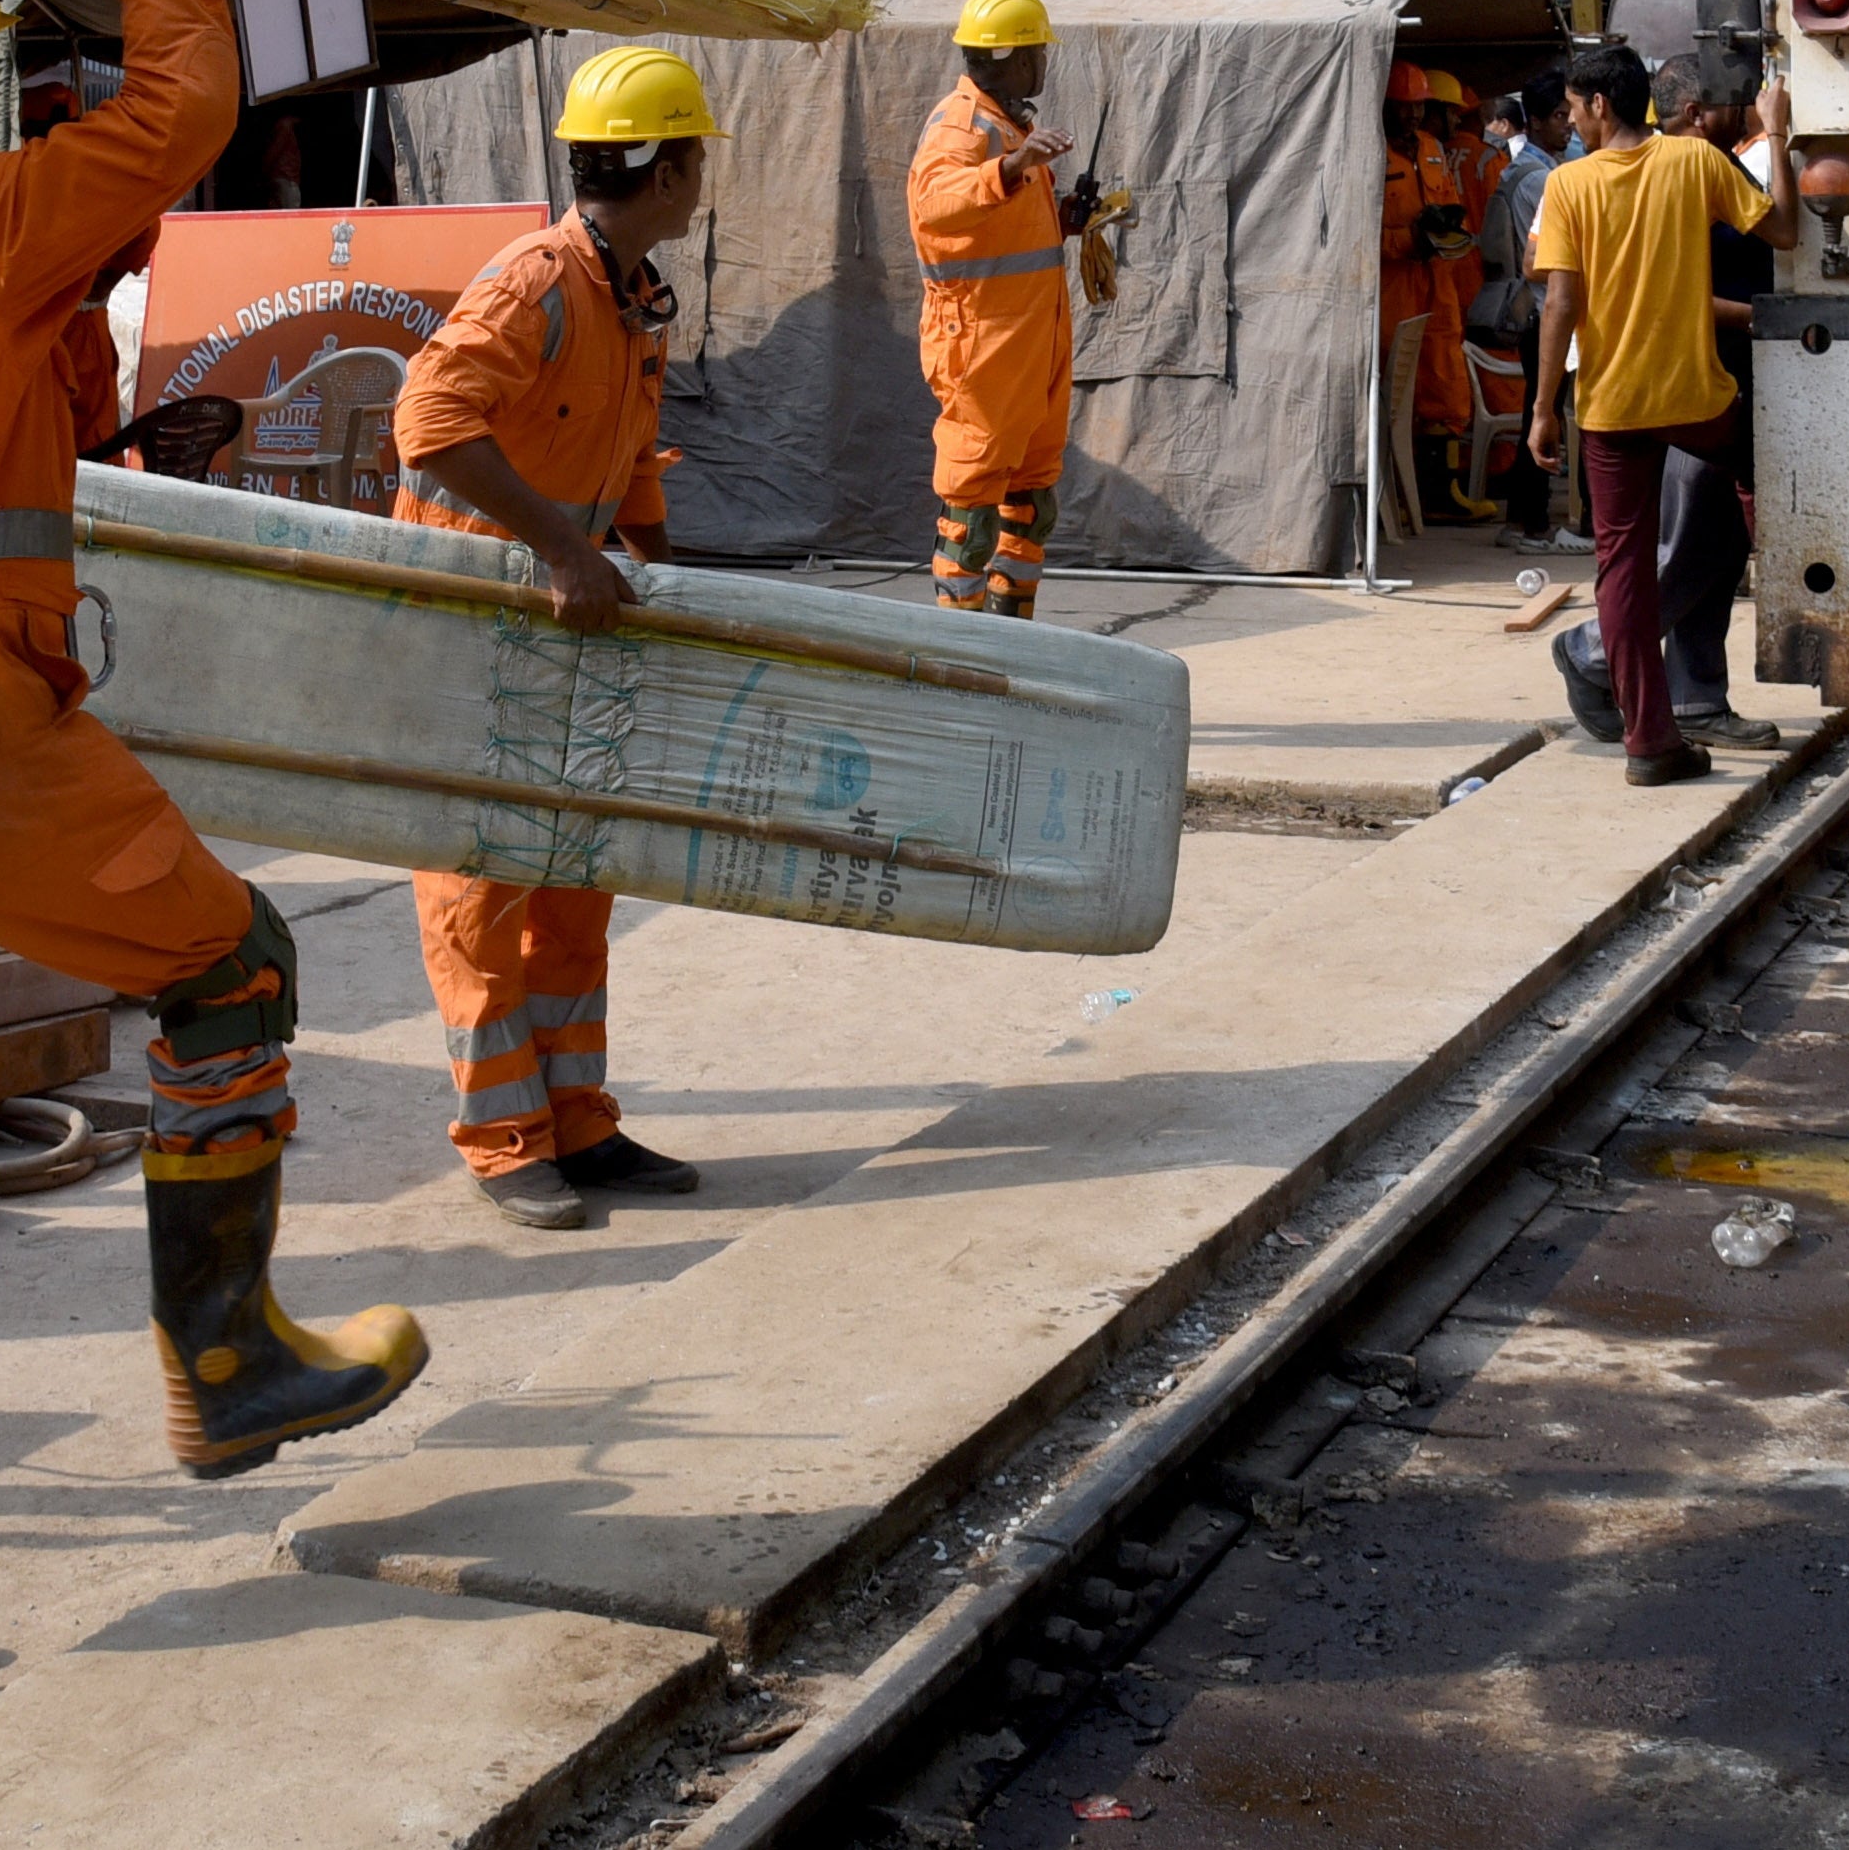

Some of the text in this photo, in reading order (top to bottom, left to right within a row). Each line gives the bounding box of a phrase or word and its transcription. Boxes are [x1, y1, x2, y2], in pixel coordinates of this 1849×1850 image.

[157, 324, 240, 408] ATIONAL
[235, 280, 345, 340] DISASTER
[256, 434, 294, 452] Saving
[989, 773, 1001, 803] Coated
